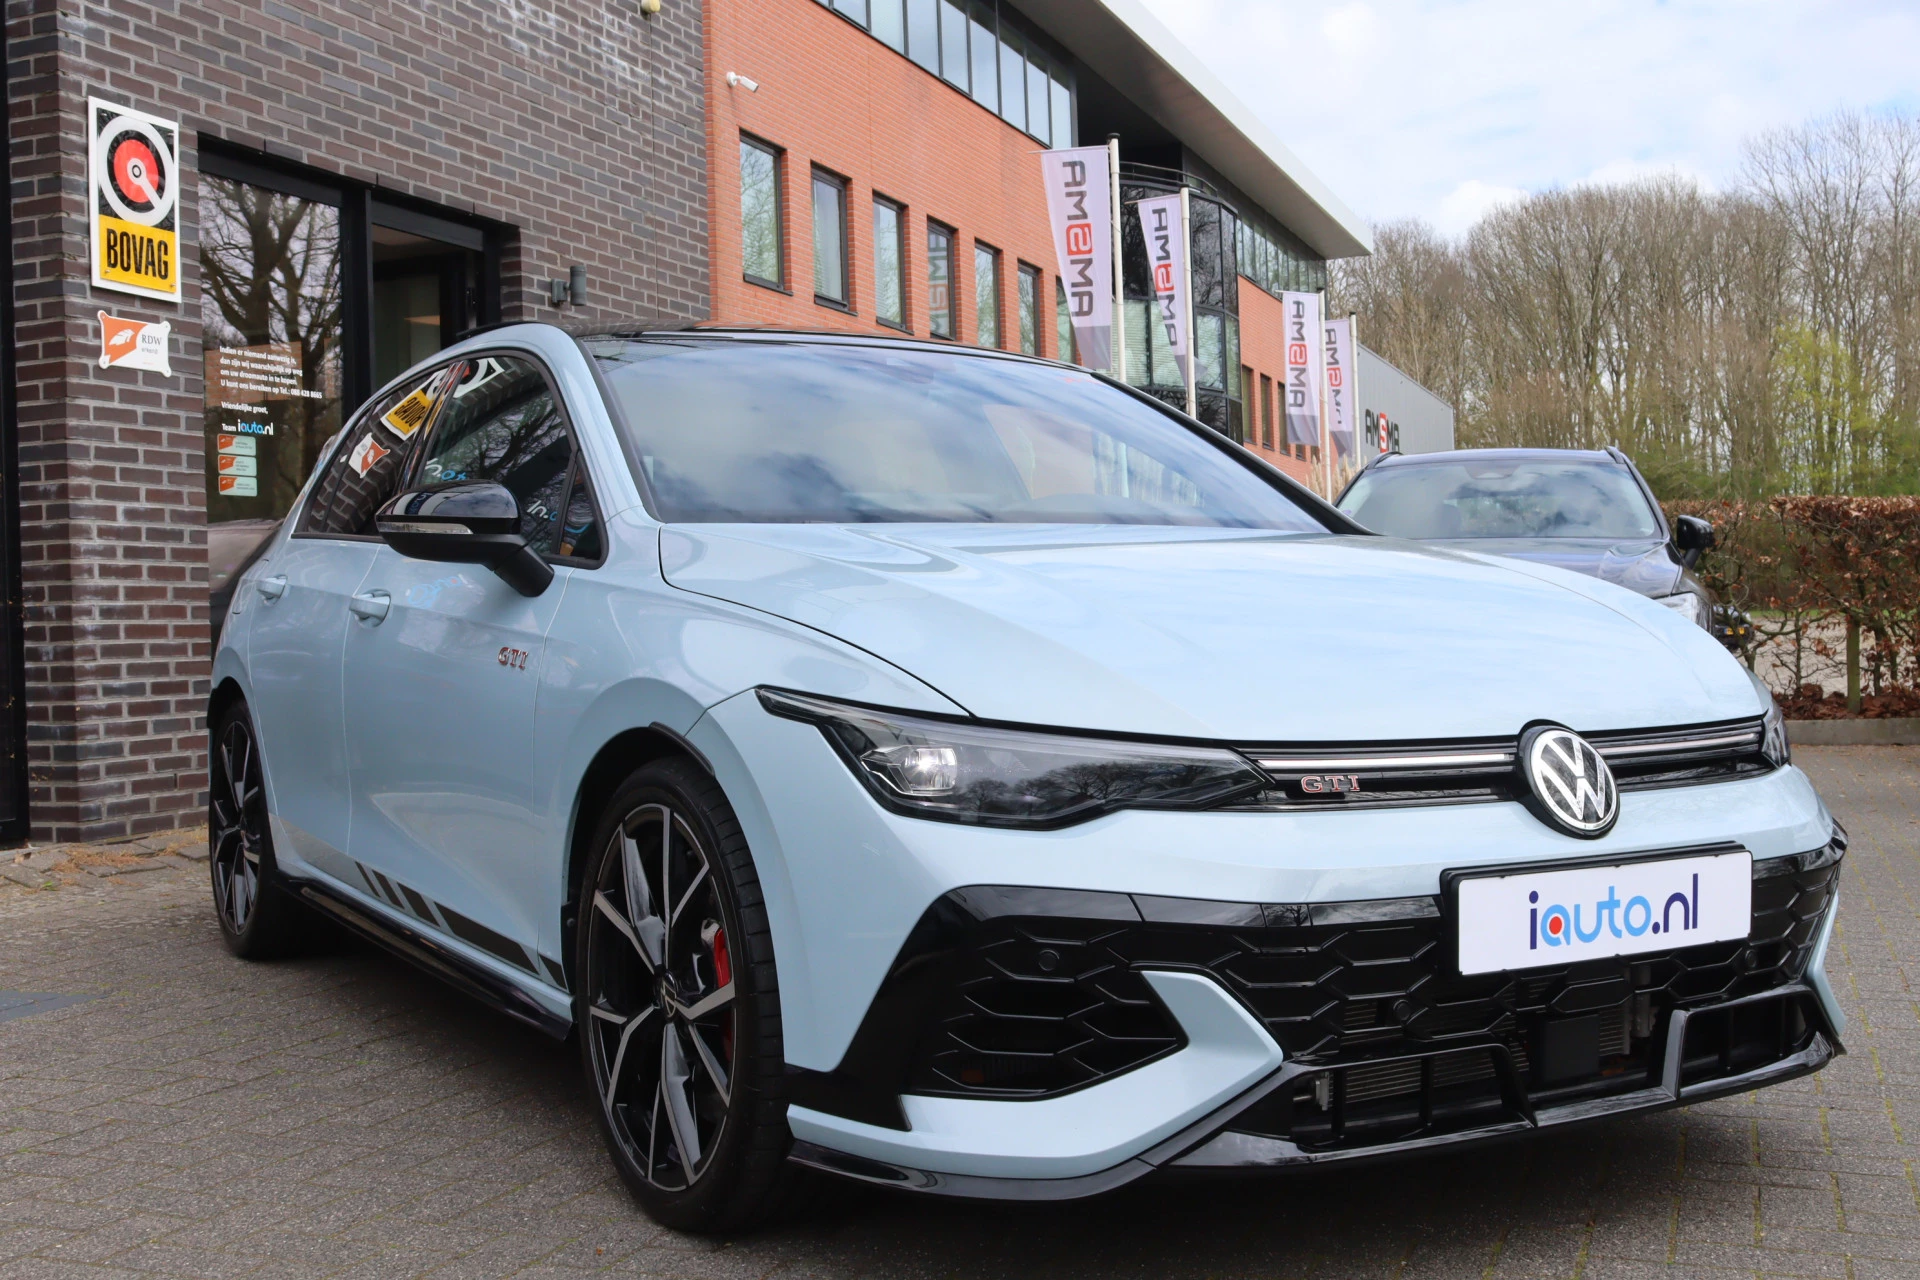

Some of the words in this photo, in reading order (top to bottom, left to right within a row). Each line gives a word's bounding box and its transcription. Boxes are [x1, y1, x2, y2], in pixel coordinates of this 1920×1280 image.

[106, 228, 169, 280] BOVAG
[141, 333, 162, 345] RDW
[220, 346, 237, 354] Indien
[244, 350, 267, 359] niemand
[220, 357, 231, 365] dan
[231, 358, 241, 367] zijn
[241, 360, 250, 369] wij
[239, 371, 268, 381] droomauto
[226, 379, 239, 388] kunt
[239, 382, 249, 390] ons
[249, 382, 272, 392] bereiken
[221, 401, 252, 412] Vriendelijke
[221, 423, 237, 432] Team
[237, 419, 274, 435] iauto.nl
[1365, 408, 1400, 453] AMSMA
[498, 646, 528, 670] GTI
[1301, 775, 1360, 793] GTI
[1529, 873, 1698, 950] iauto.nl
